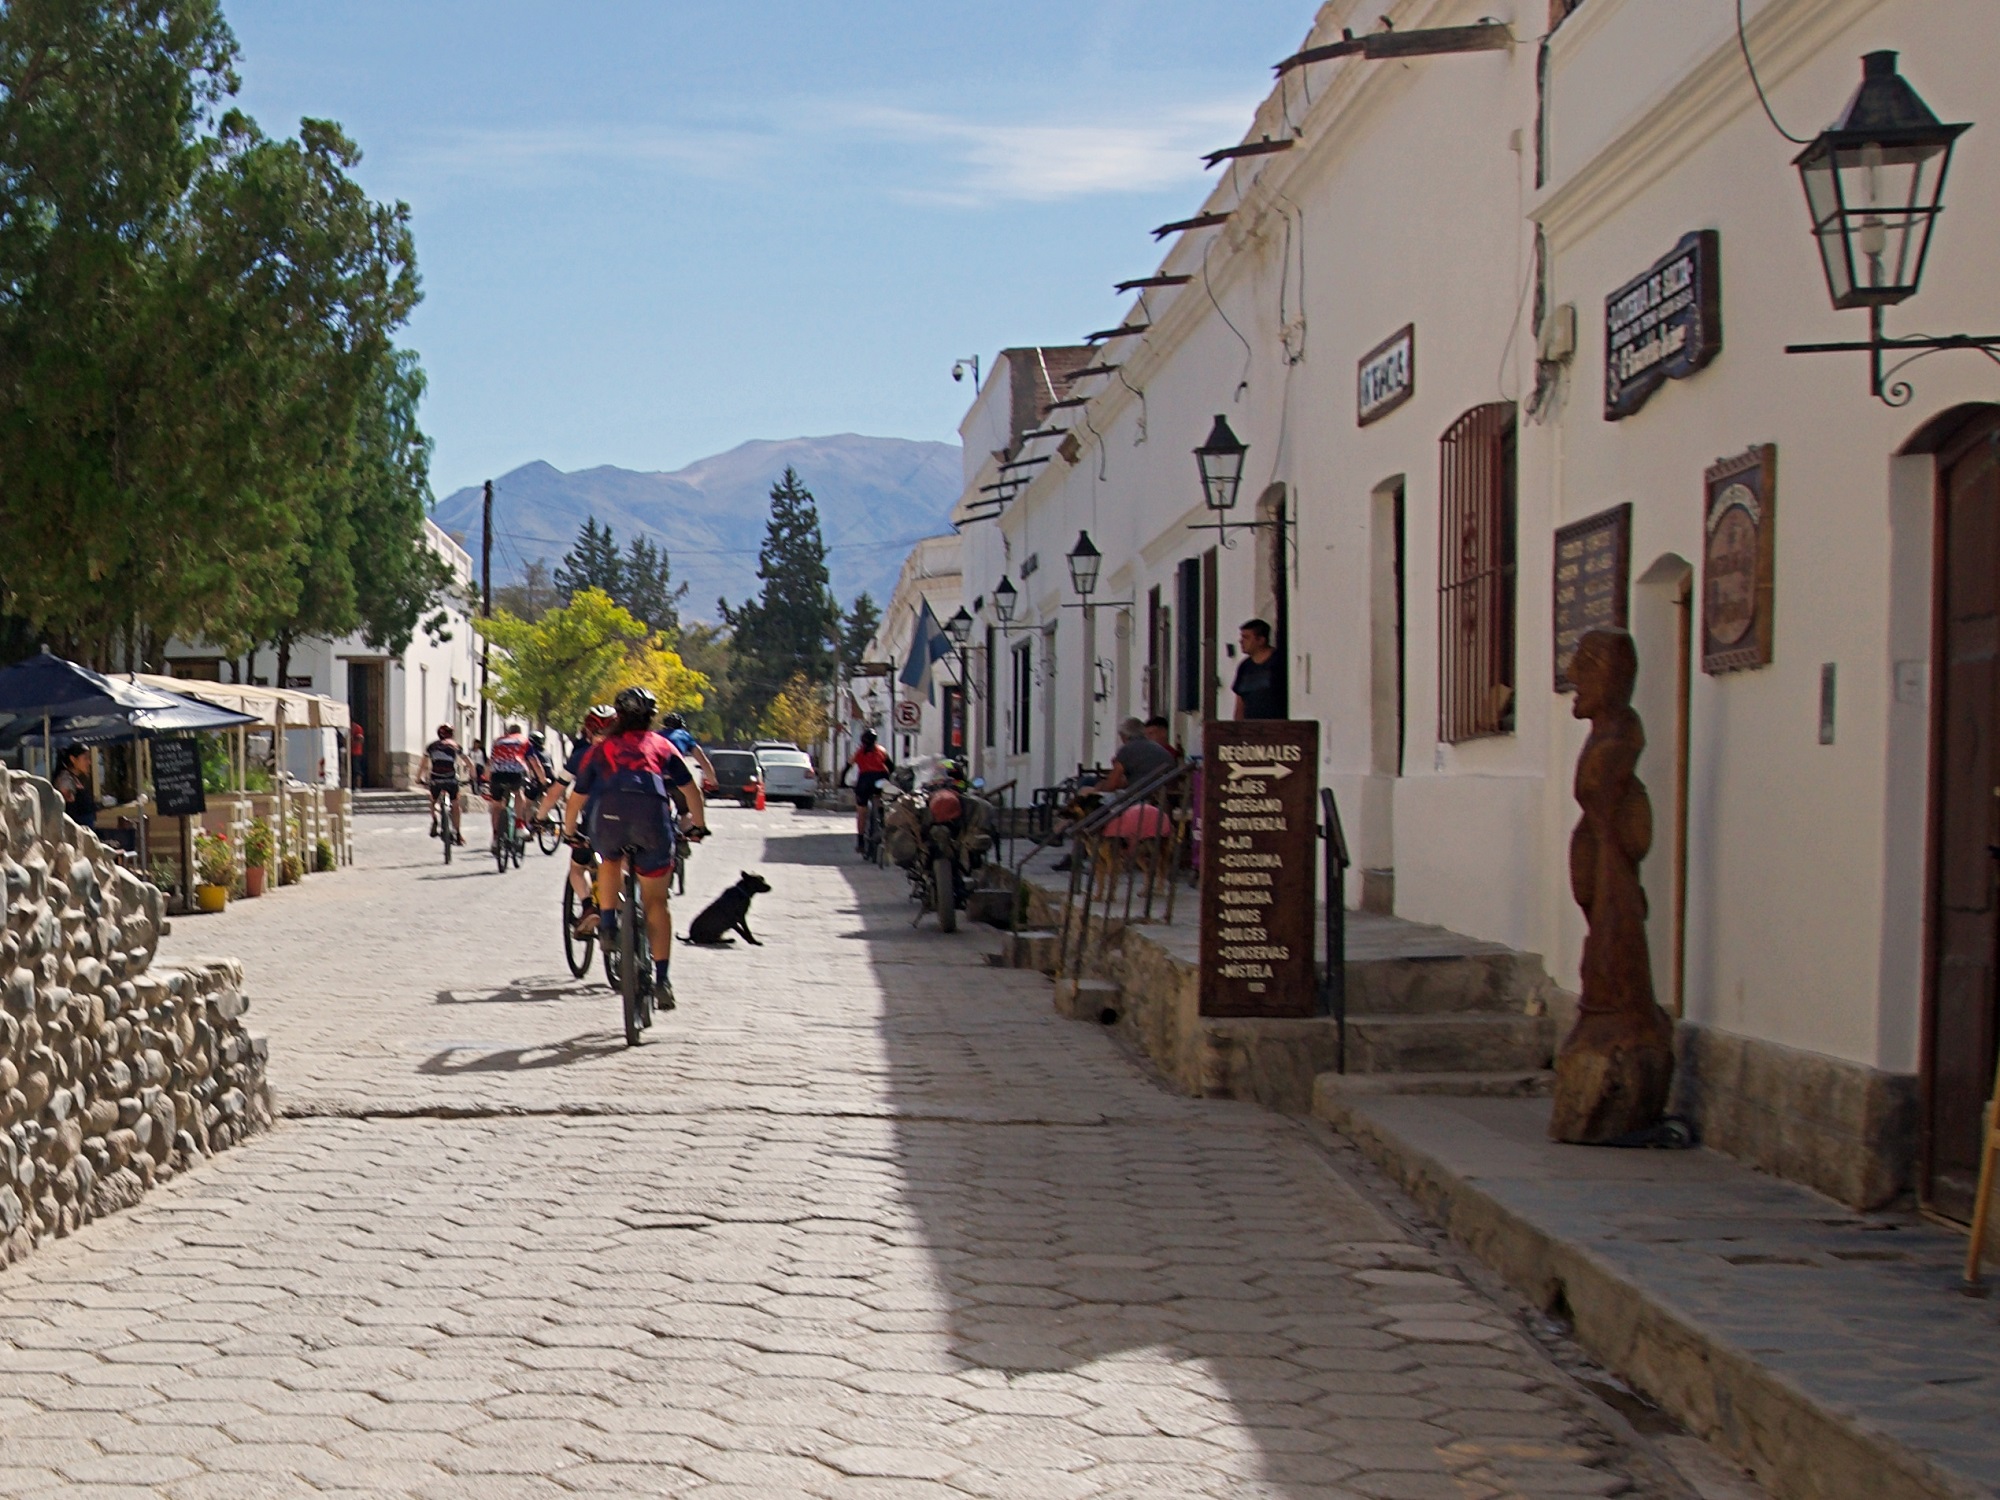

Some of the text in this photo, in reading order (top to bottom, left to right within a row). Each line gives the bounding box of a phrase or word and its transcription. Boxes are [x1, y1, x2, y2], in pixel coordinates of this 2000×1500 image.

[1225, 817, 1288, 831] PROVENZAL
[1226, 835, 1252, 849] AJO
[1224, 909, 1261, 923] VINOS
[1224, 927, 1268, 941] DULCES
[1224, 945, 1290, 960] CONSERVAS
